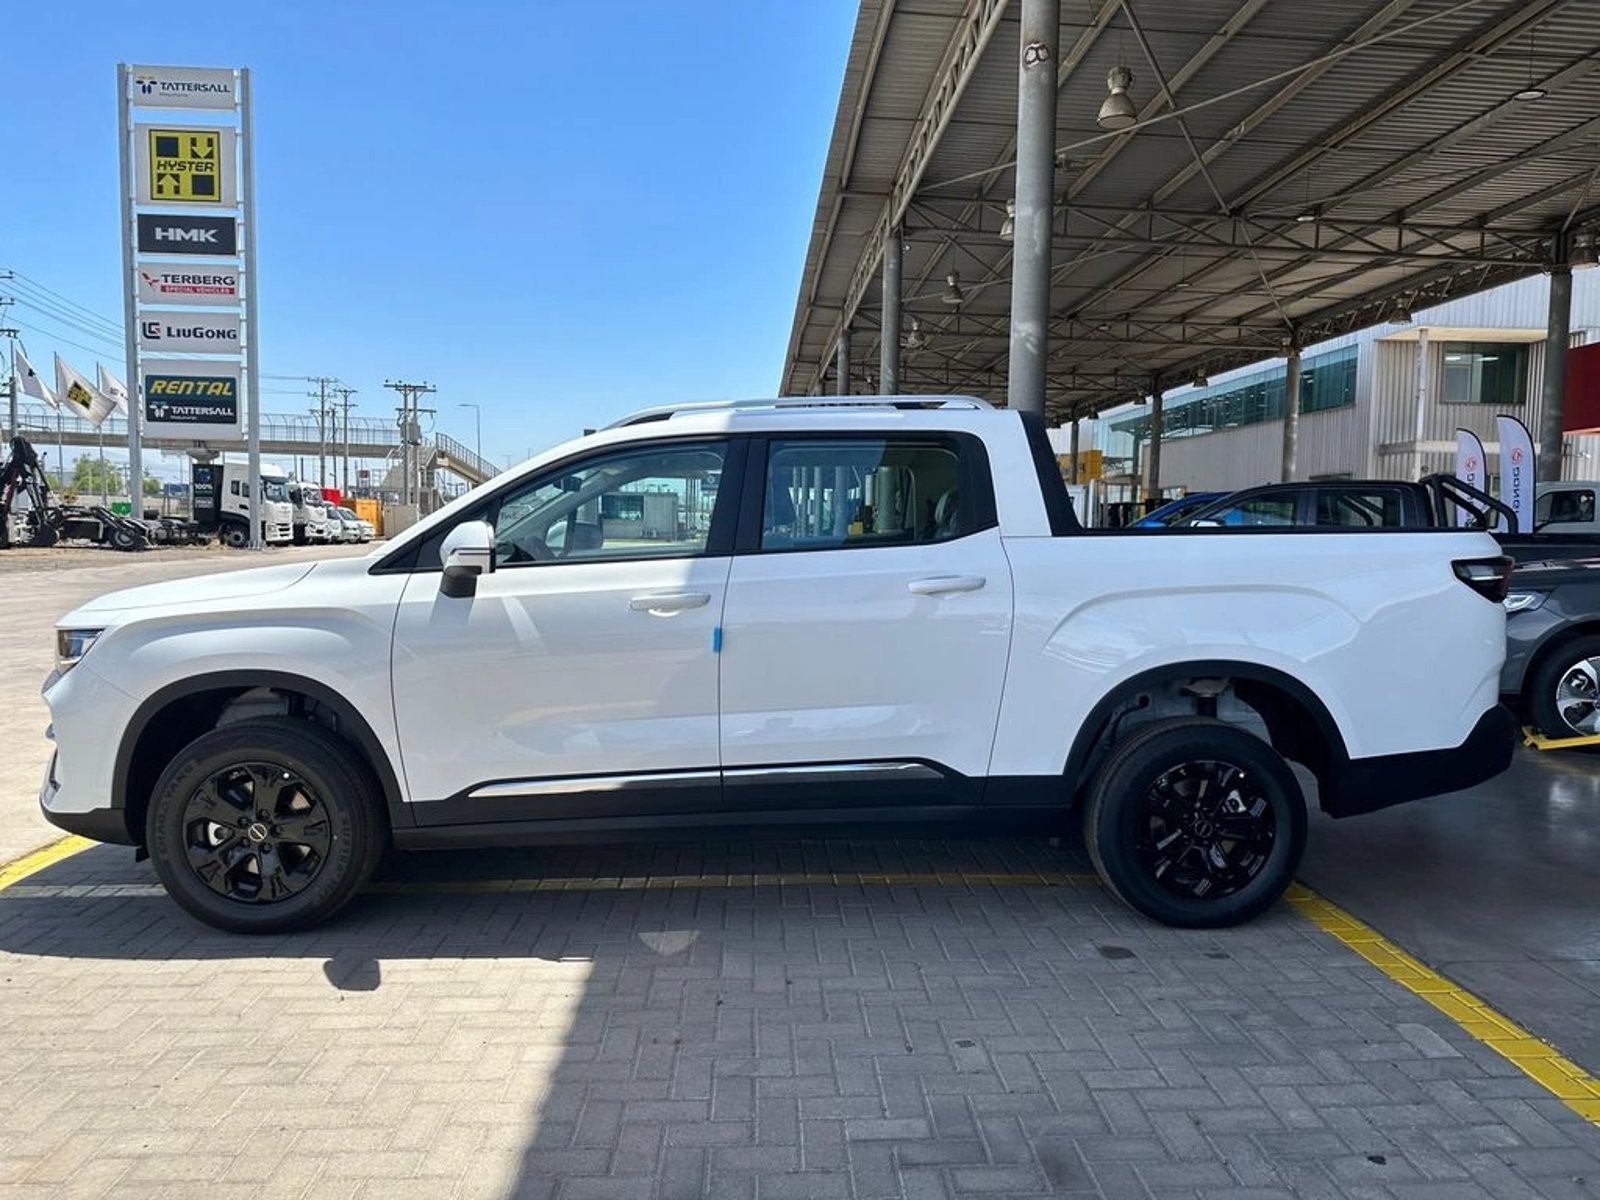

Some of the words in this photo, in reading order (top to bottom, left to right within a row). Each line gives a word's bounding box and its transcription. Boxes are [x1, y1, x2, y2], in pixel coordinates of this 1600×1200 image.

[160, 82, 231, 93] TATTERSALL
[156, 160, 214, 172] HYSTER
[155, 227, 218, 243] HMK
[161, 274, 235, 286] TERBERG
[149, 380, 233, 396] RENTAL
[171, 405, 234, 417] TATTERSALL
